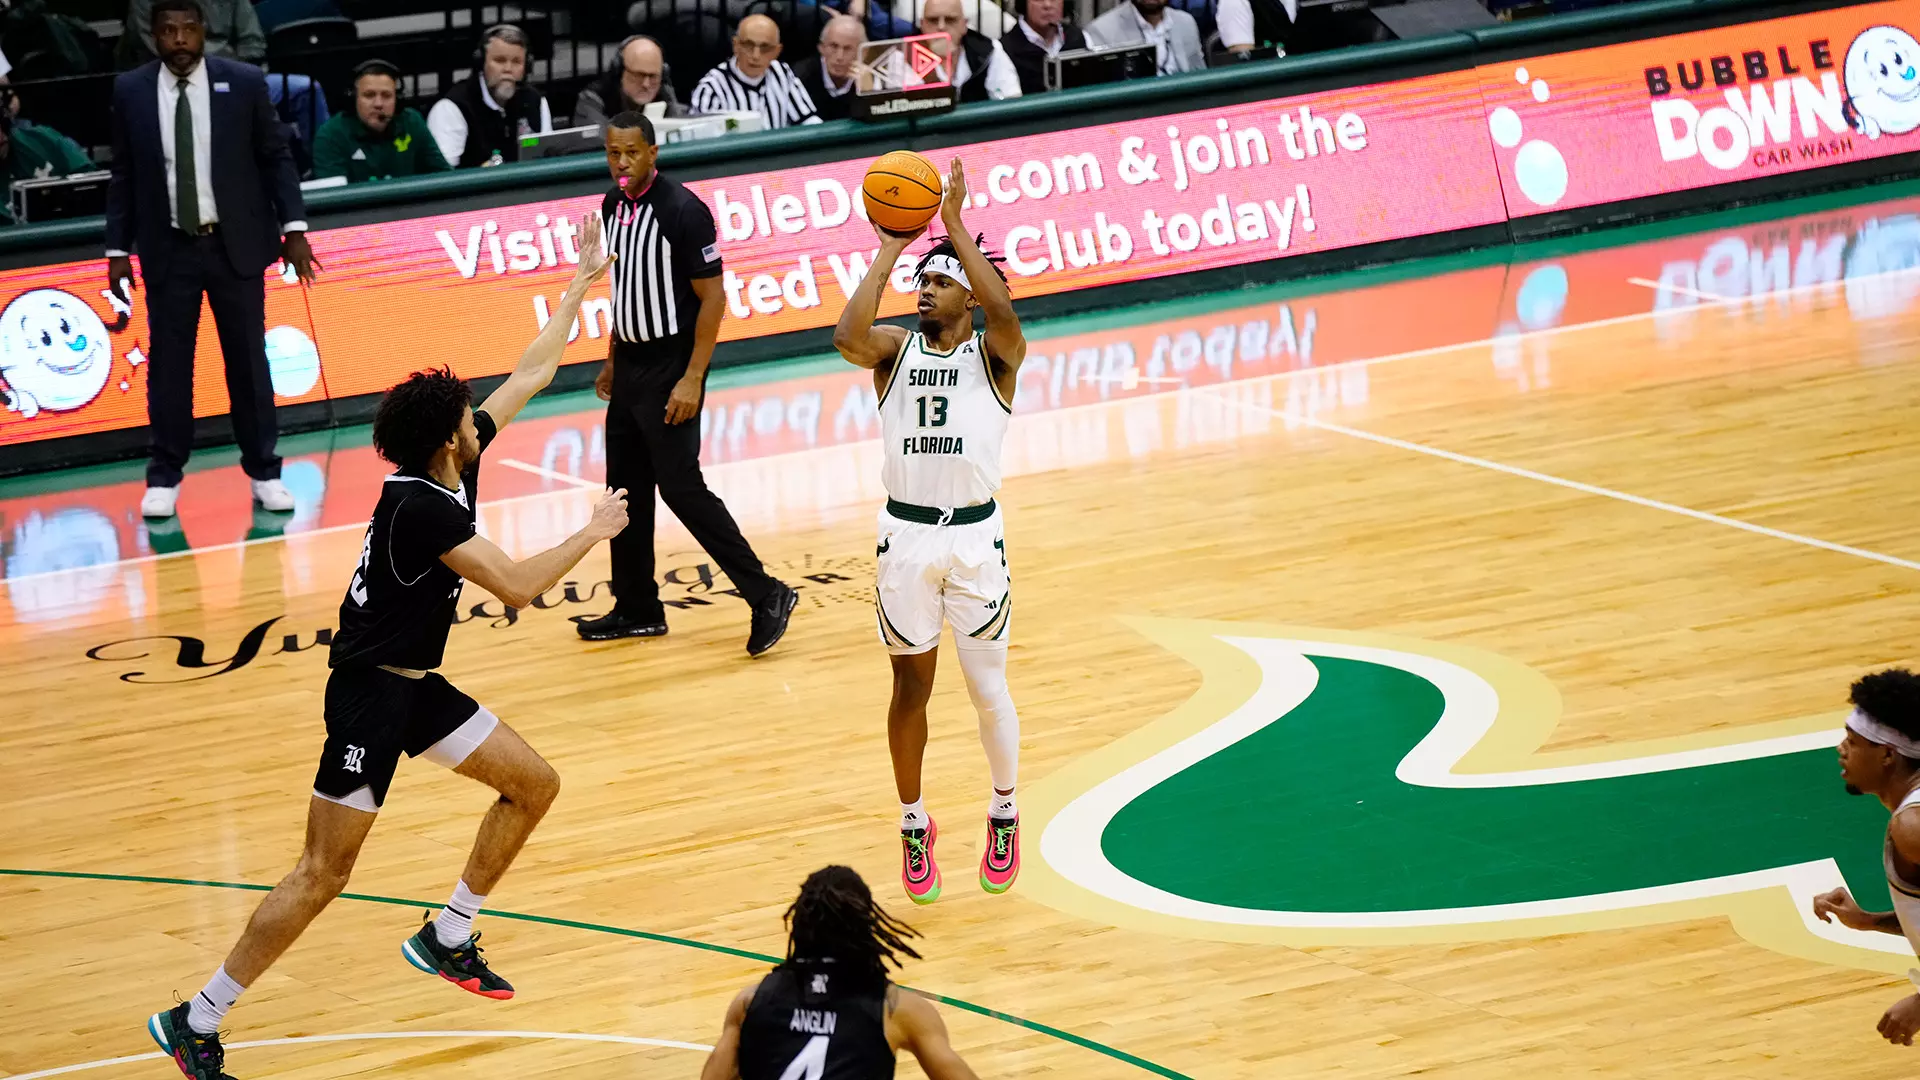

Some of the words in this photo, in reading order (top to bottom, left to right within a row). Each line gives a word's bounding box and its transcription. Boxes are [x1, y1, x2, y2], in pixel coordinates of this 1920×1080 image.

[1644, 39, 1835, 96] BUBBLE
[1753, 148, 1793, 168] CAR
[1799, 138, 1854, 161] WASH
[435, 212, 581, 279] Visit
[1118, 136, 1161, 185] &
[1167, 118, 1270, 191] join
[1278, 105, 1368, 160] the
[1004, 211, 1134, 277] Club
[1142, 184, 1317, 250] today!
[908, 369, 959, 387] SOUTH
[915, 394, 950, 430] 13
[903, 436, 963, 456] FLORIDA
[790, 1008, 838, 1035] ANGLIN
